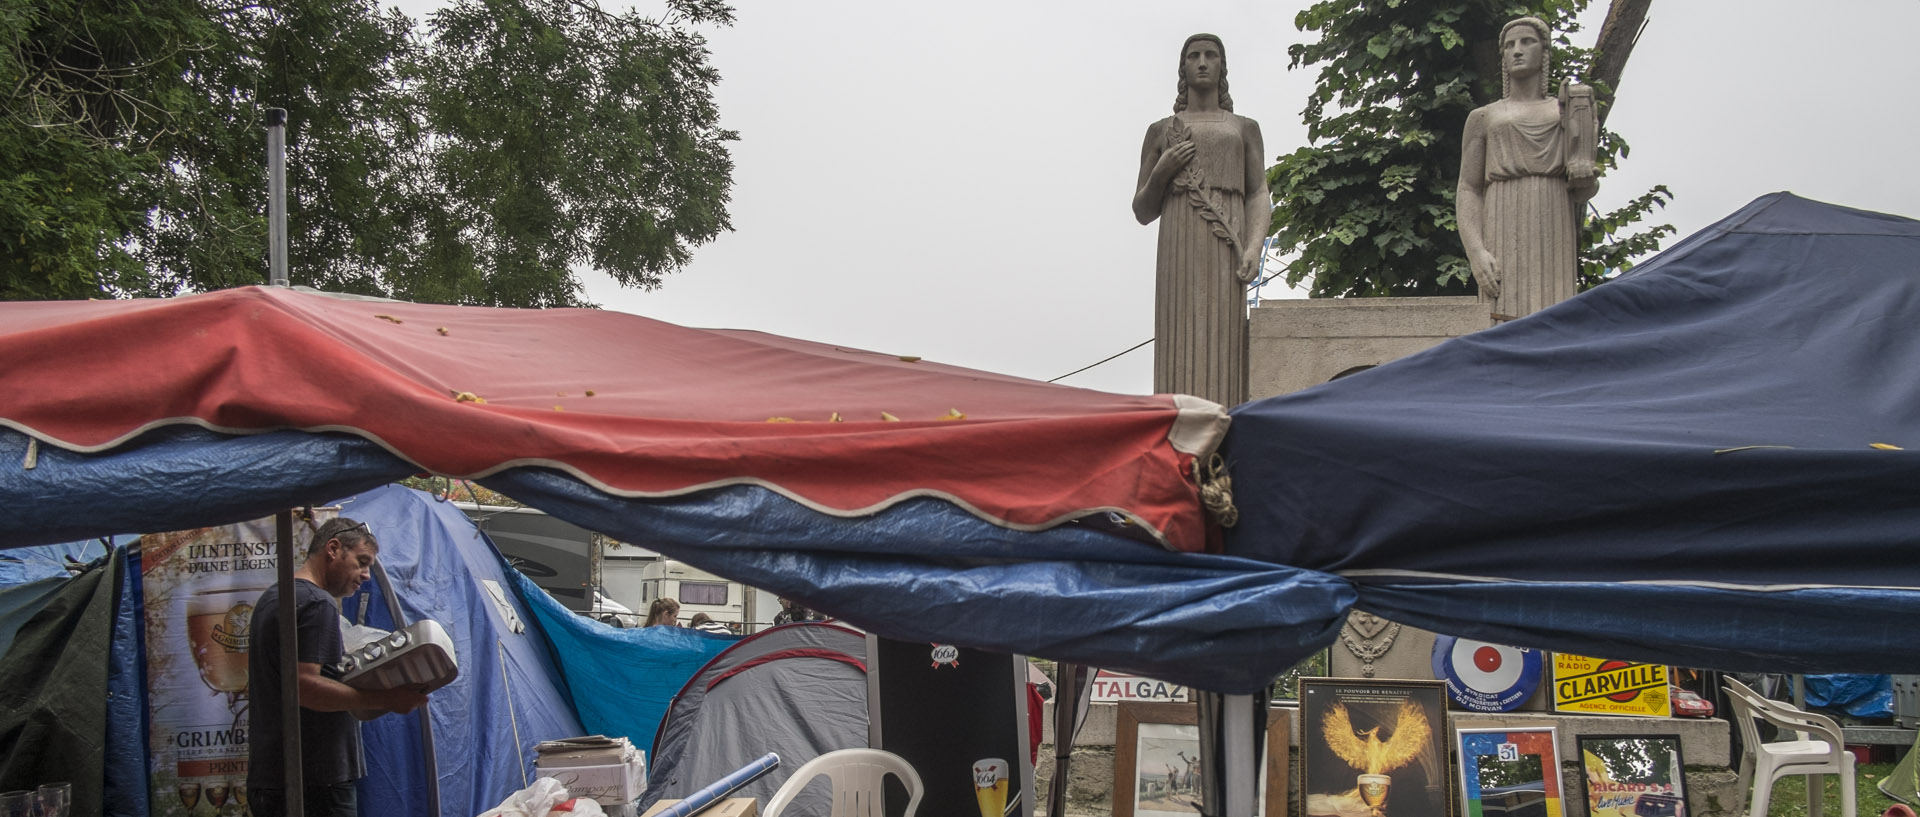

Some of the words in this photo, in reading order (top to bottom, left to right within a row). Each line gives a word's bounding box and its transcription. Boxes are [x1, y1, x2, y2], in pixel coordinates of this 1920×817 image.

[934, 647, 956, 659] 1664
[1558, 663, 1591, 671] RADIO
[1559, 665, 1664, 700] CLARVILLE
[1465, 687, 1498, 699] SYNDICAT
[1456, 695, 1467, 705] DU
[1469, 703, 1502, 711] MORVAN
[1579, 703, 1606, 711] AGENCE
[1609, 704, 1646, 712] OFFICIELLE
[1501, 746, 1516, 760] 51
[209, 761, 248, 773] PRINT
[1593, 782, 1646, 792] RICARD
